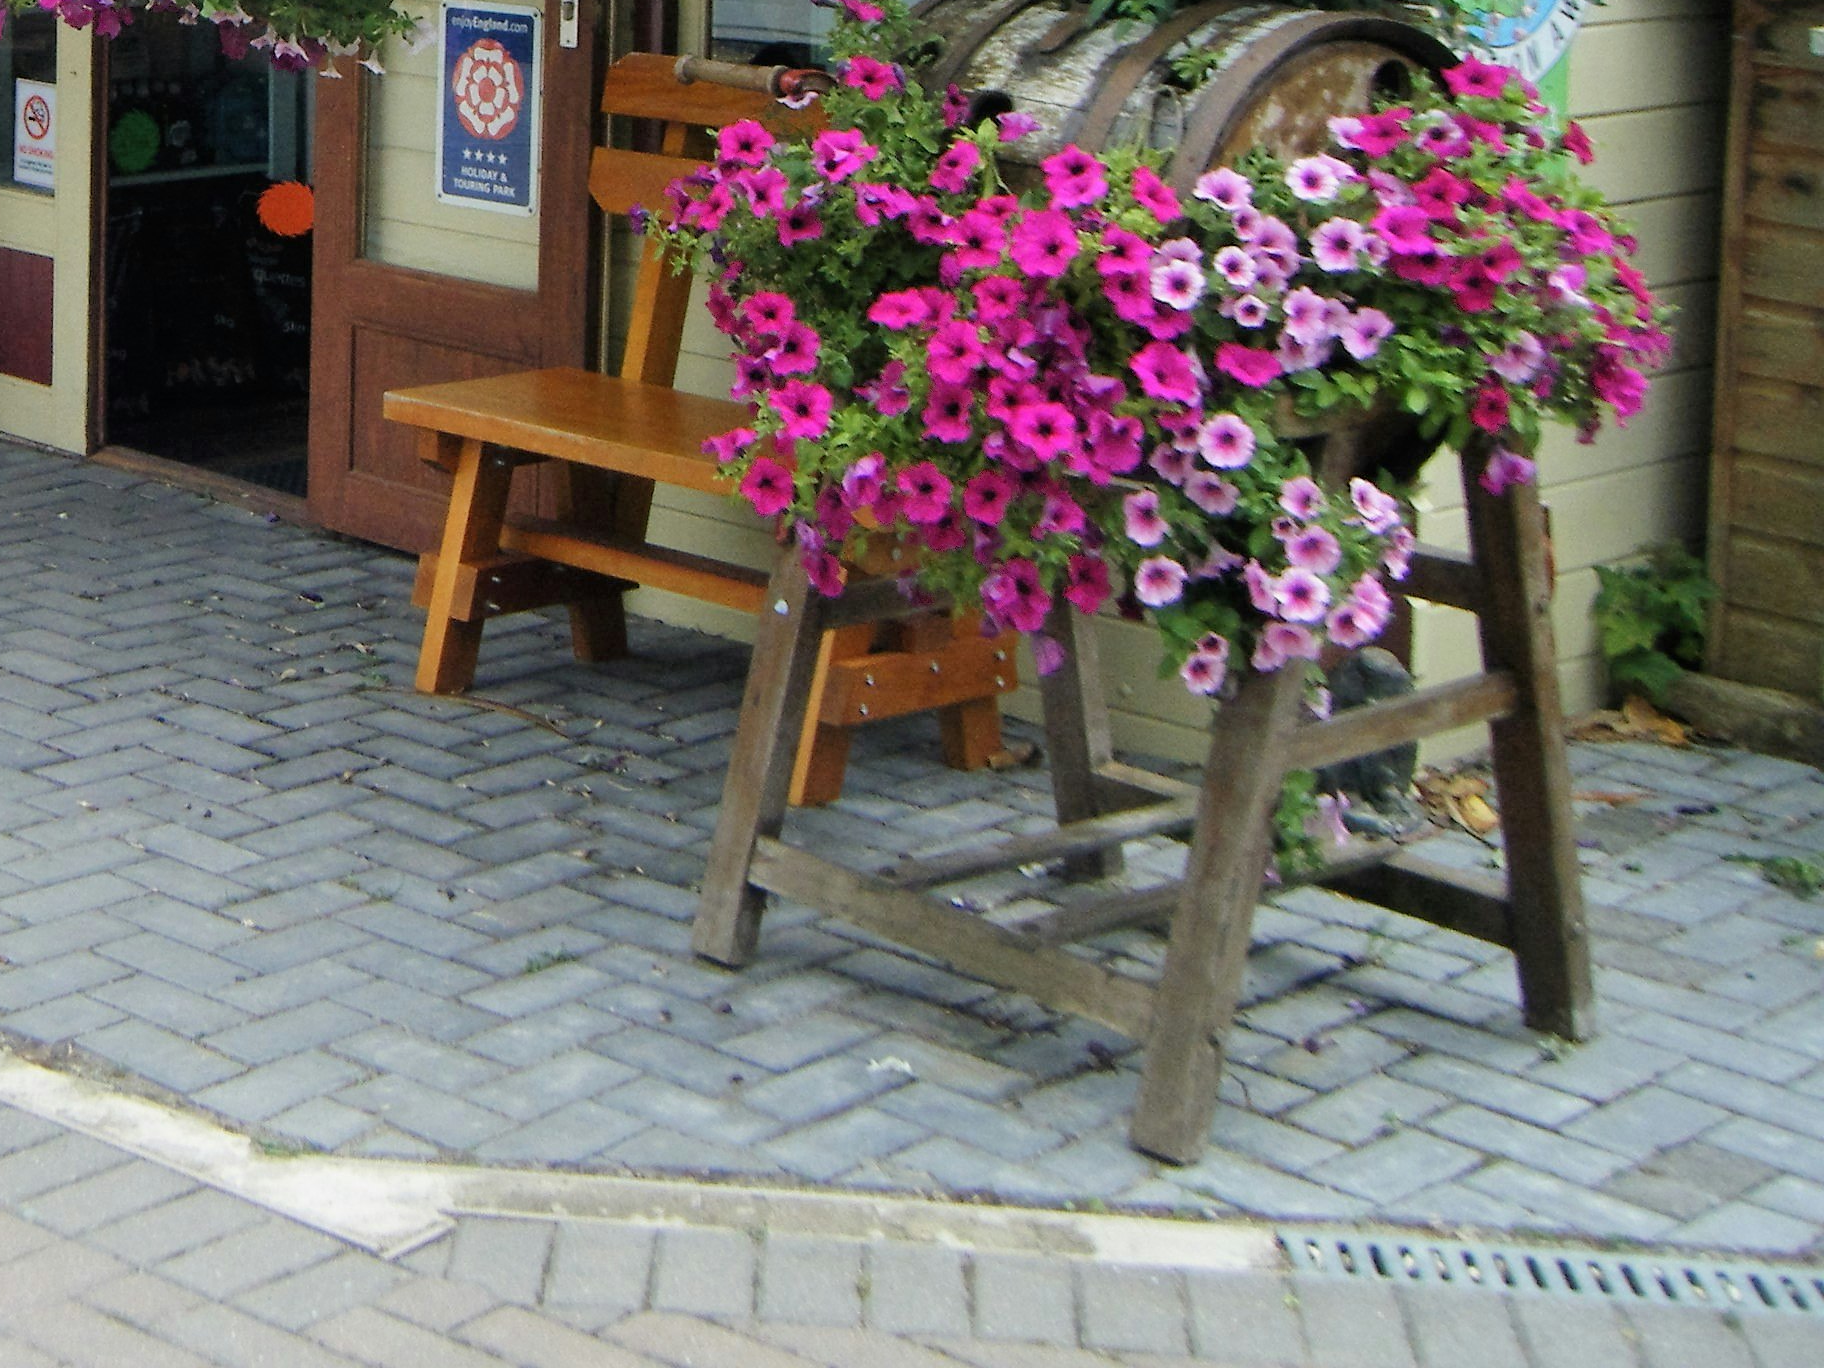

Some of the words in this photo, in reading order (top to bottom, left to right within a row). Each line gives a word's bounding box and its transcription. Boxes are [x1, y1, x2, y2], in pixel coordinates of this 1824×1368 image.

[450, 15, 529, 34] enjoyEngland.com
[460, 165, 498, 181] HOLIDAY
[499, 172, 508, 183] &
[454, 178, 491, 194] TOURING
[492, 183, 516, 198] PARK
